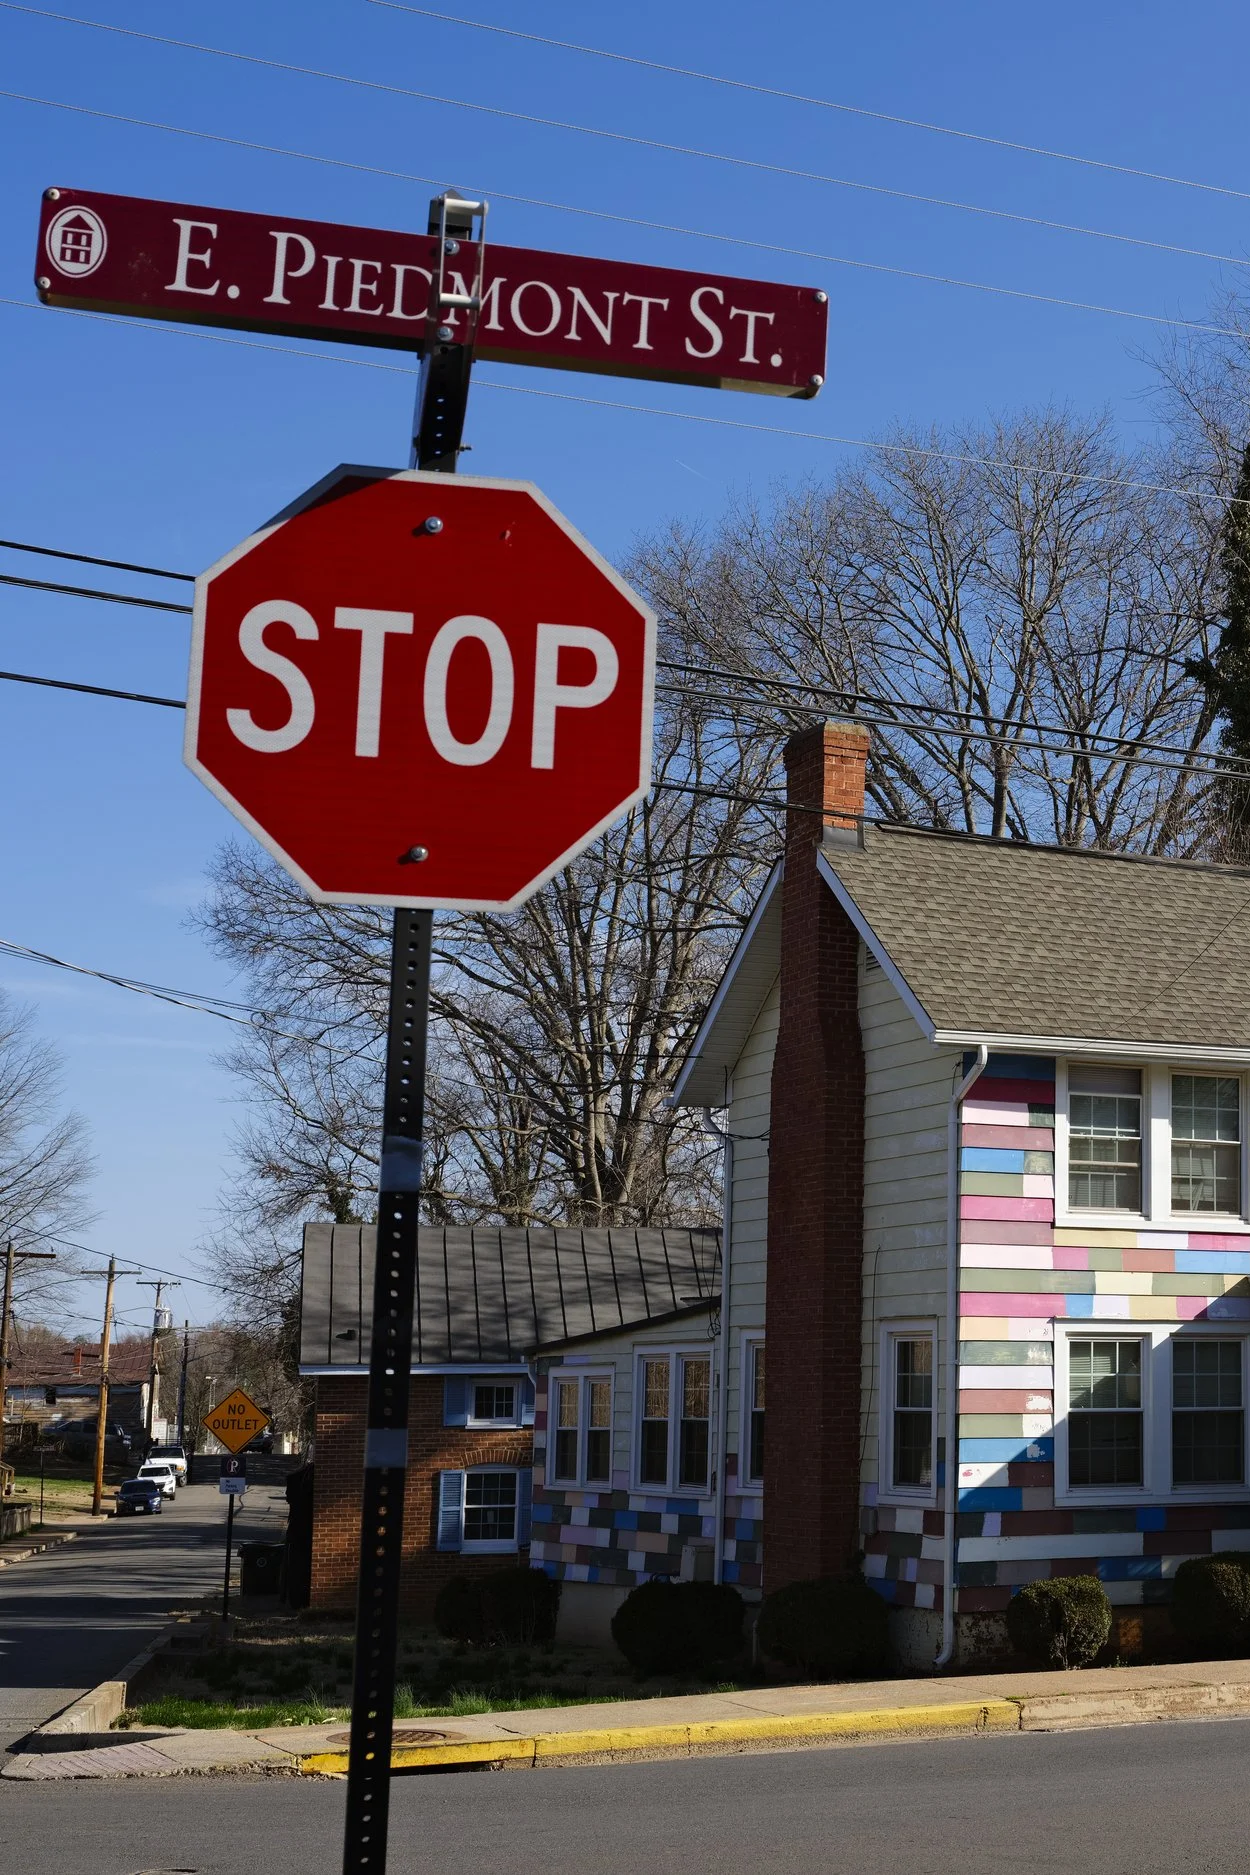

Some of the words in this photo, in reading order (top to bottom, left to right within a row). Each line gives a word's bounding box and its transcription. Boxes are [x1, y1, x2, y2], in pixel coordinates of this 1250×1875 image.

[164, 218, 240, 299] E.
[263, 230, 670, 350] PIEDMONT
[685, 286, 783, 368] ST.
[227, 600, 619, 770] STOP
[212, 1418, 259, 1430] OUTLET
[227, 1404, 246, 1415] NO
